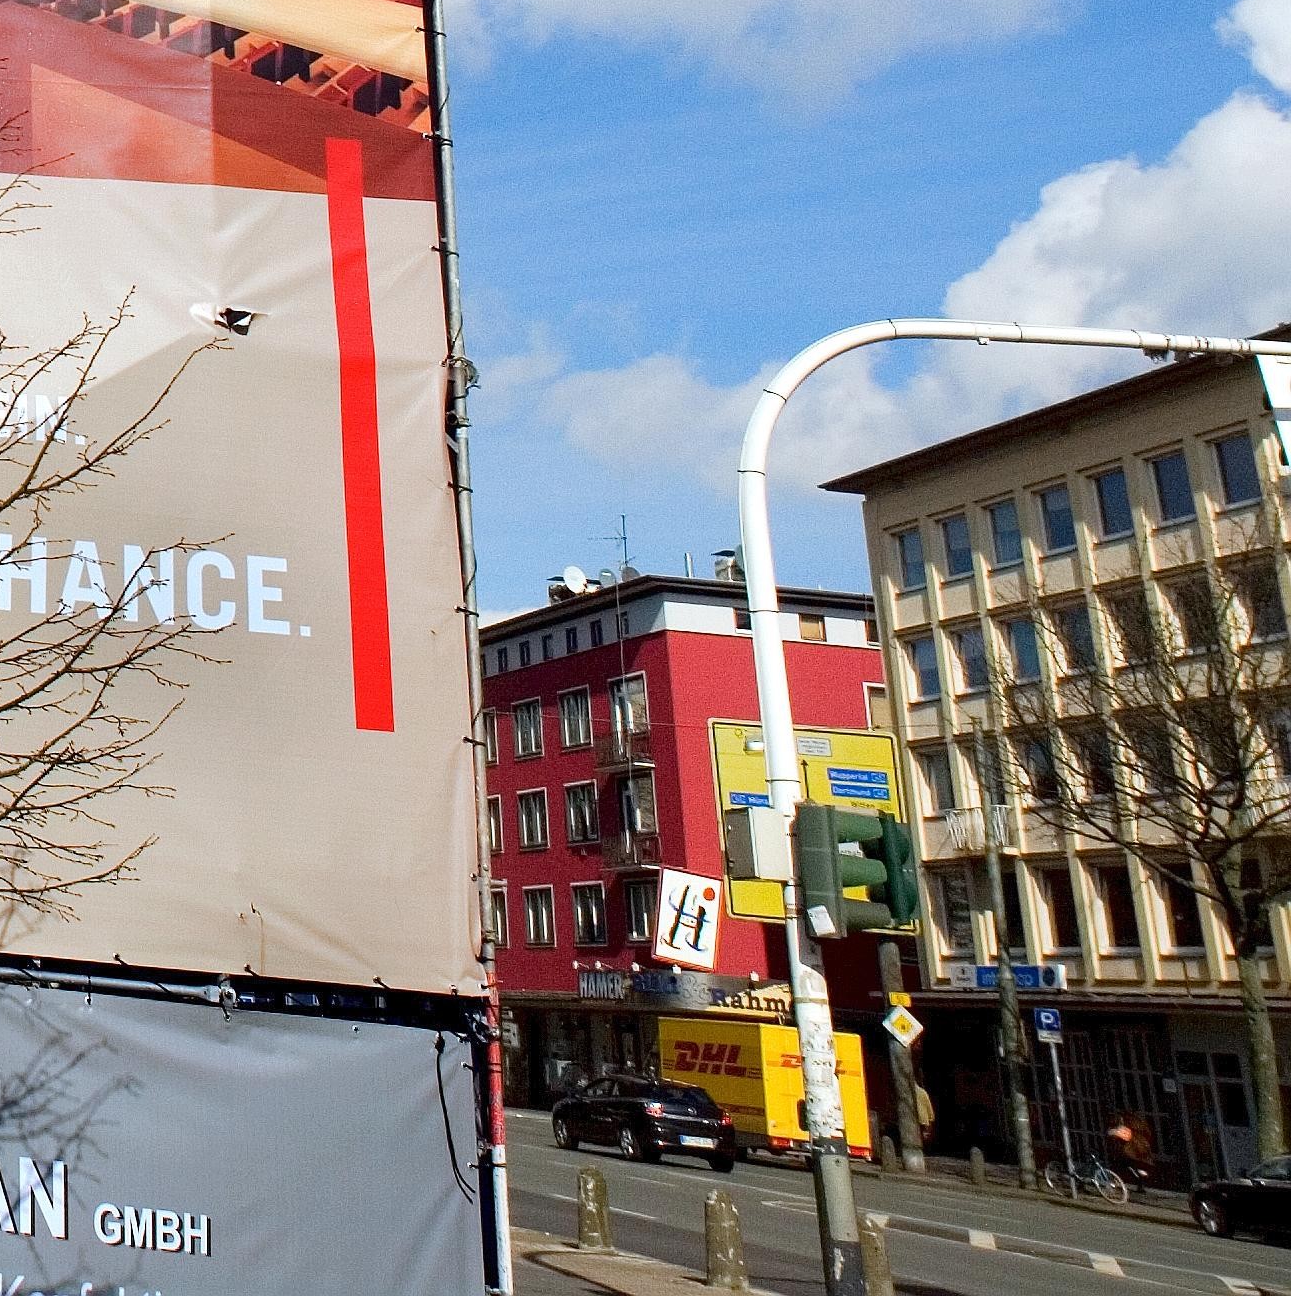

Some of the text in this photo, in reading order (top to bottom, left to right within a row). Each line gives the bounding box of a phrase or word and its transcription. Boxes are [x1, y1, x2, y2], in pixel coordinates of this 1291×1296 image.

[579, 972, 624, 1000] HAMER
[674, 1040, 747, 1077] DHL
[93, 1202, 212, 1258] GMBH
